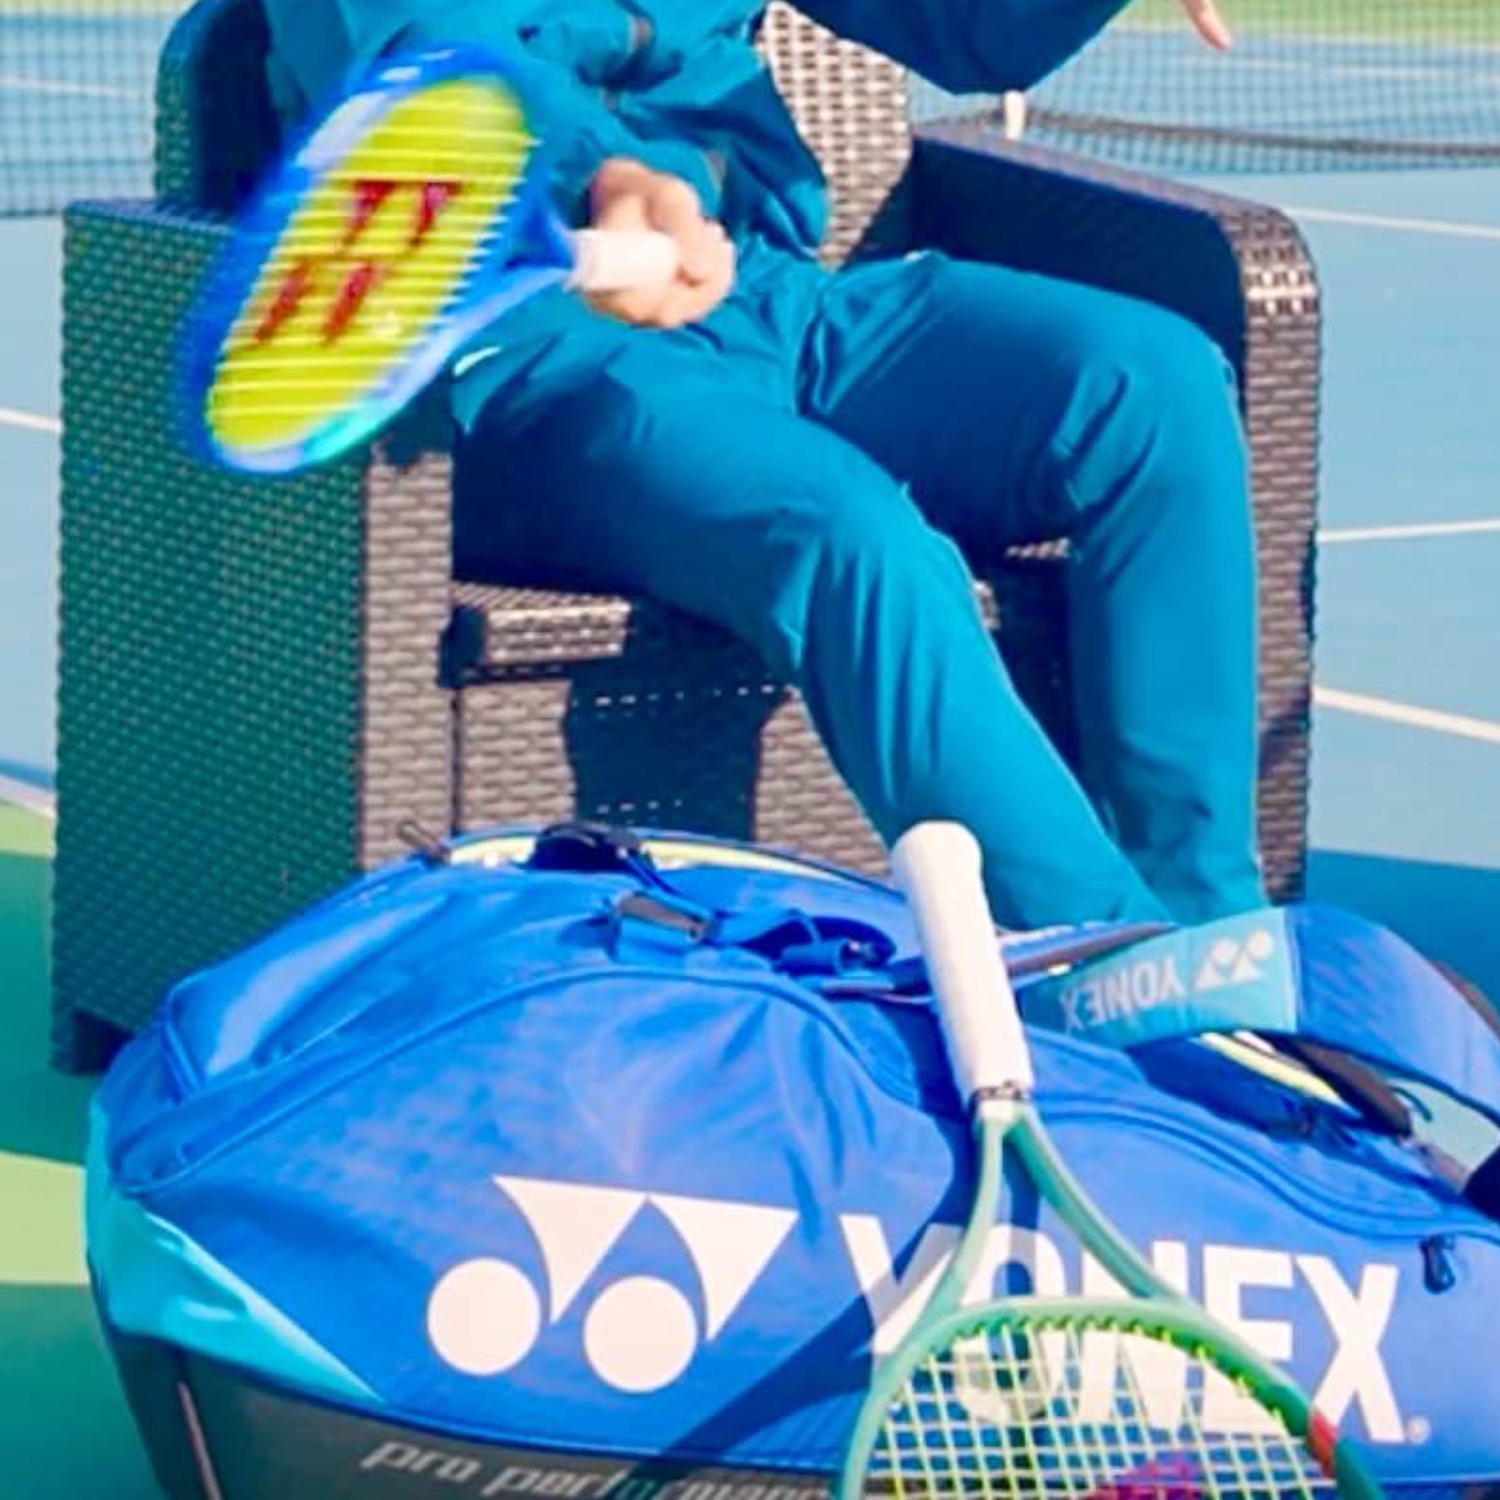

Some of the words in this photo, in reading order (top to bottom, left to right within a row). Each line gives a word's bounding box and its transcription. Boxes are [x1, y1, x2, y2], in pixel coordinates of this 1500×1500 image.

[1058, 954, 1187, 1035] YONEX
[838, 1212, 1407, 1444] YONEX
[360, 1440, 483, 1483] pro
[481, 1462, 830, 1500] performan
